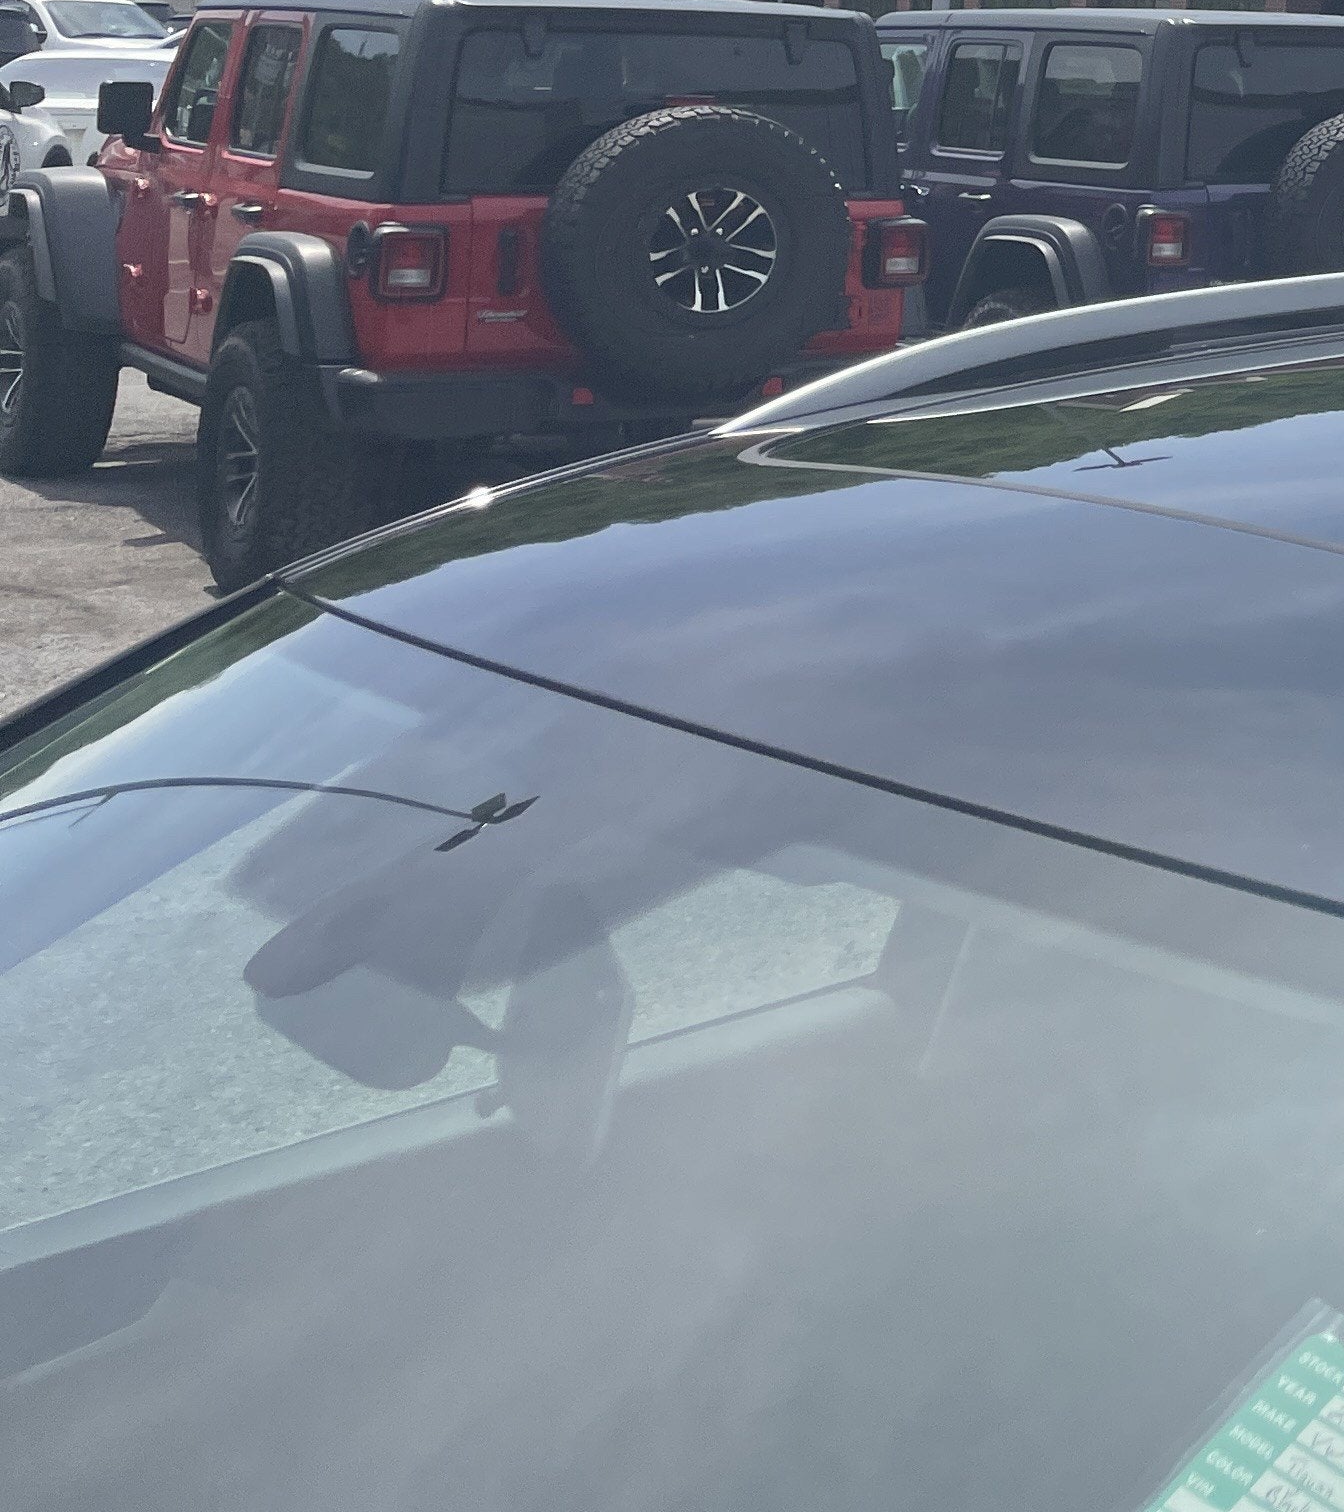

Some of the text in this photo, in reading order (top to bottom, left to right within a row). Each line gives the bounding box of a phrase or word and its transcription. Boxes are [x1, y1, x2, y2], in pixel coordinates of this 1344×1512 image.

[1299, 1351, 1344, 1384] STOCK
[1277, 1374, 1317, 1406] YEAR
[1252, 1399, 1297, 1433] MAKE
[1229, 1423, 1274, 1460] MODEL
[1186, 1471, 1216, 1497] VIN
[1206, 1449, 1254, 1486] COLOR
